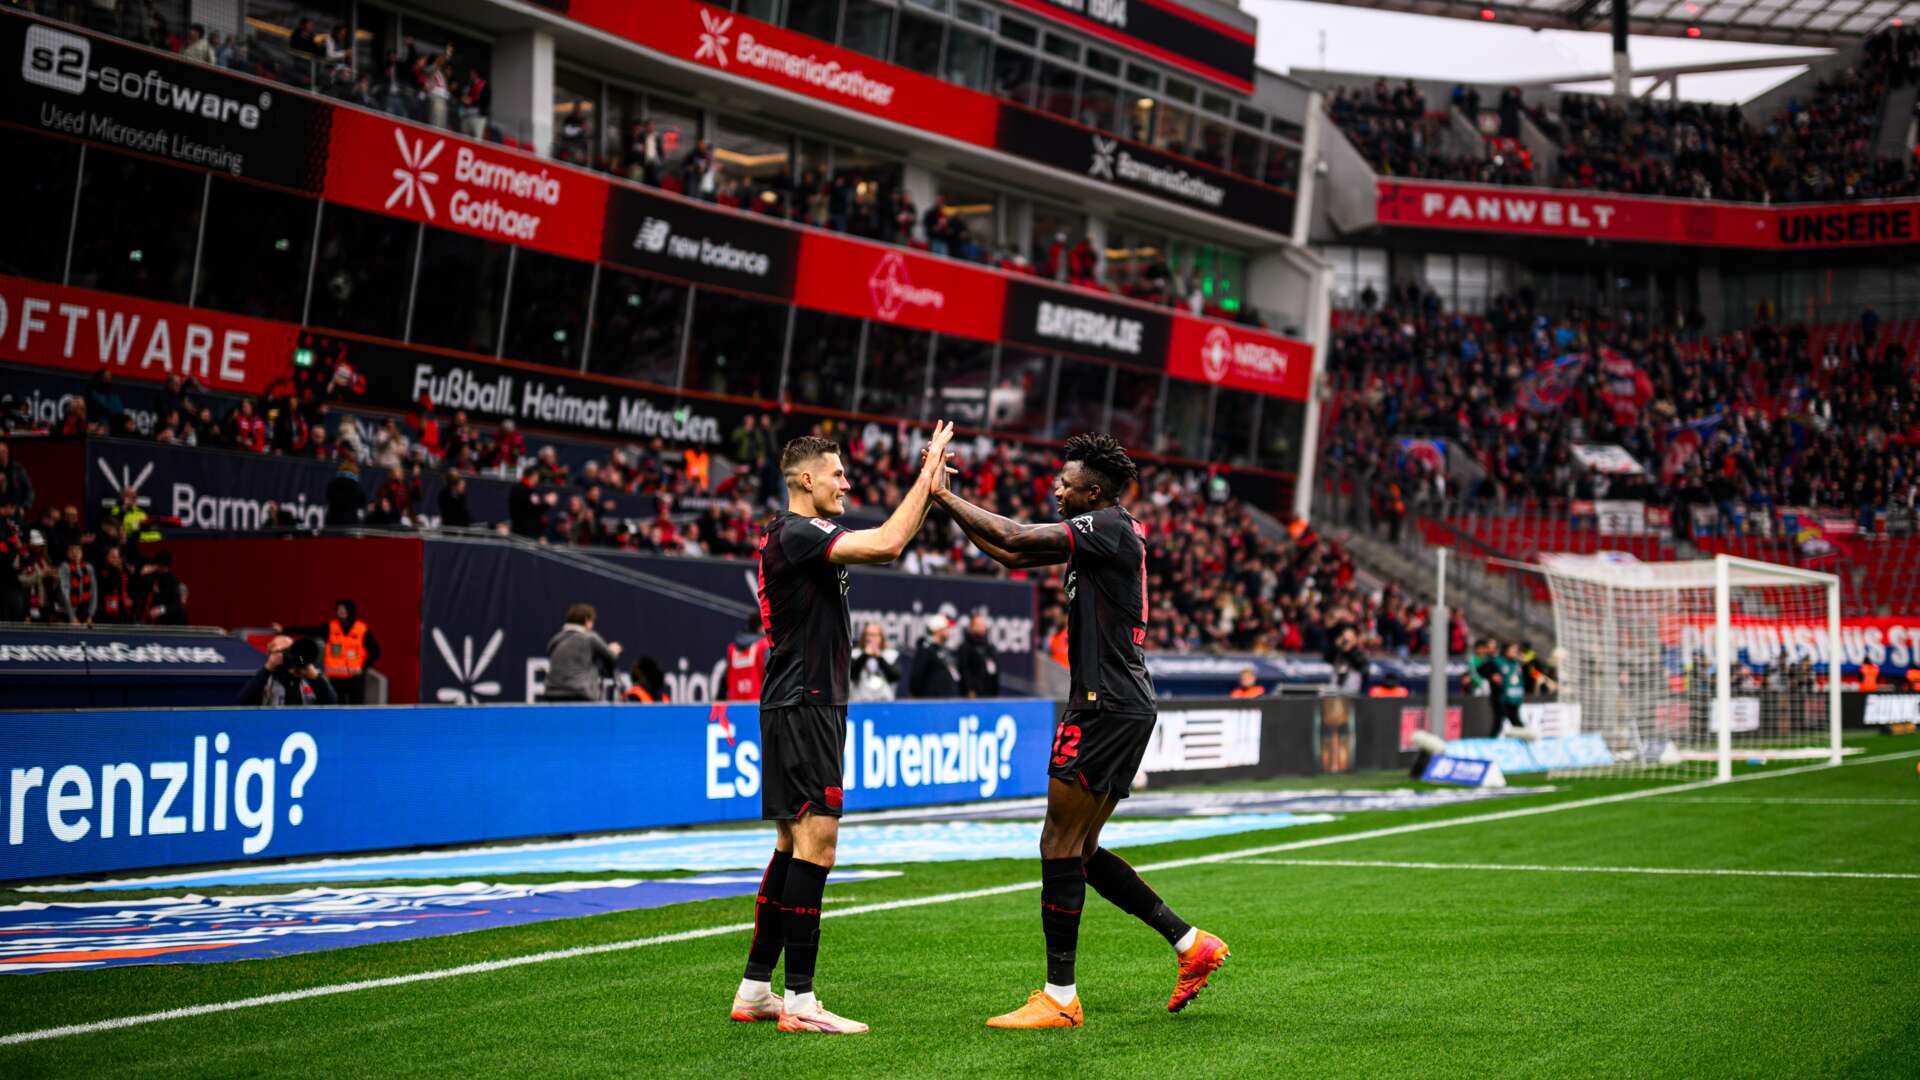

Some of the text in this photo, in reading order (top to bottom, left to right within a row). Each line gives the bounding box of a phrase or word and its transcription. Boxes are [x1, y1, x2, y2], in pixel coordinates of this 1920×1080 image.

[39, 101, 243, 176] Used Microsoft Licensing
[454, 146, 560, 205] Barmenia
[449, 190, 541, 241] Gothaer
[1779, 208, 1912, 244] UNSERE
[412, 364, 720, 444] Fußball. Heimat. Mitreden.
[706, 723, 761, 800] Es
[863, 714, 1018, 798] brenzlig?
[1050, 721, 1082, 759] 12
[0, 731, 318, 855] renzlig?
